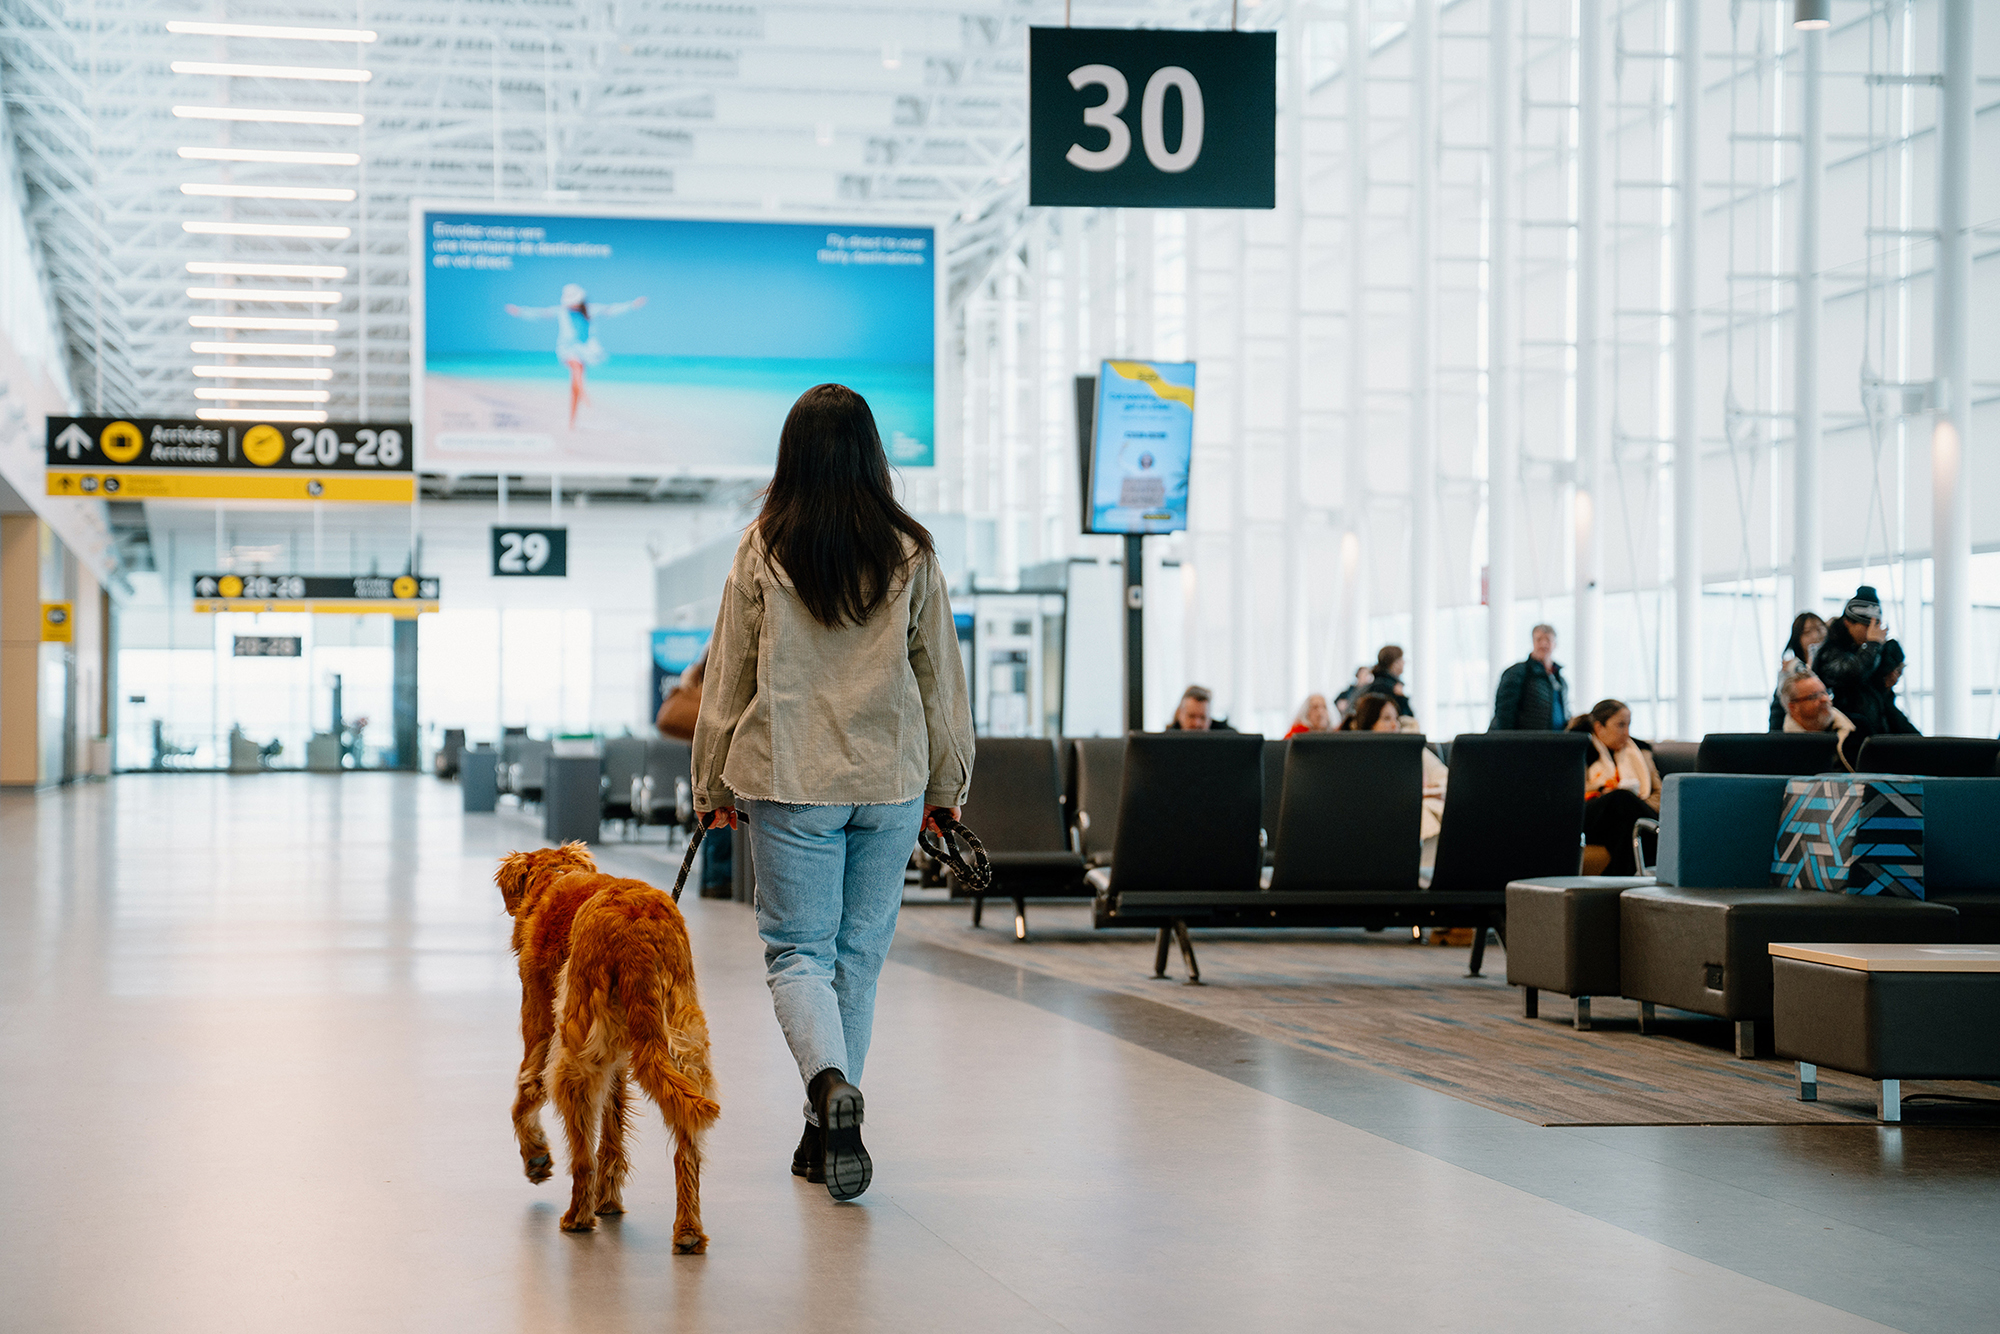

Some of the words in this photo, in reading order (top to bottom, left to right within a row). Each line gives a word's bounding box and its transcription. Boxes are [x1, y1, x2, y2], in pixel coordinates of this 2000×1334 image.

[1065, 64, 1205, 173] 30
[150, 424, 222, 445] Arrivées
[150, 443, 219, 462] Arrivals
[291, 427, 403, 466] 20-28
[499, 532, 551, 573] 29
